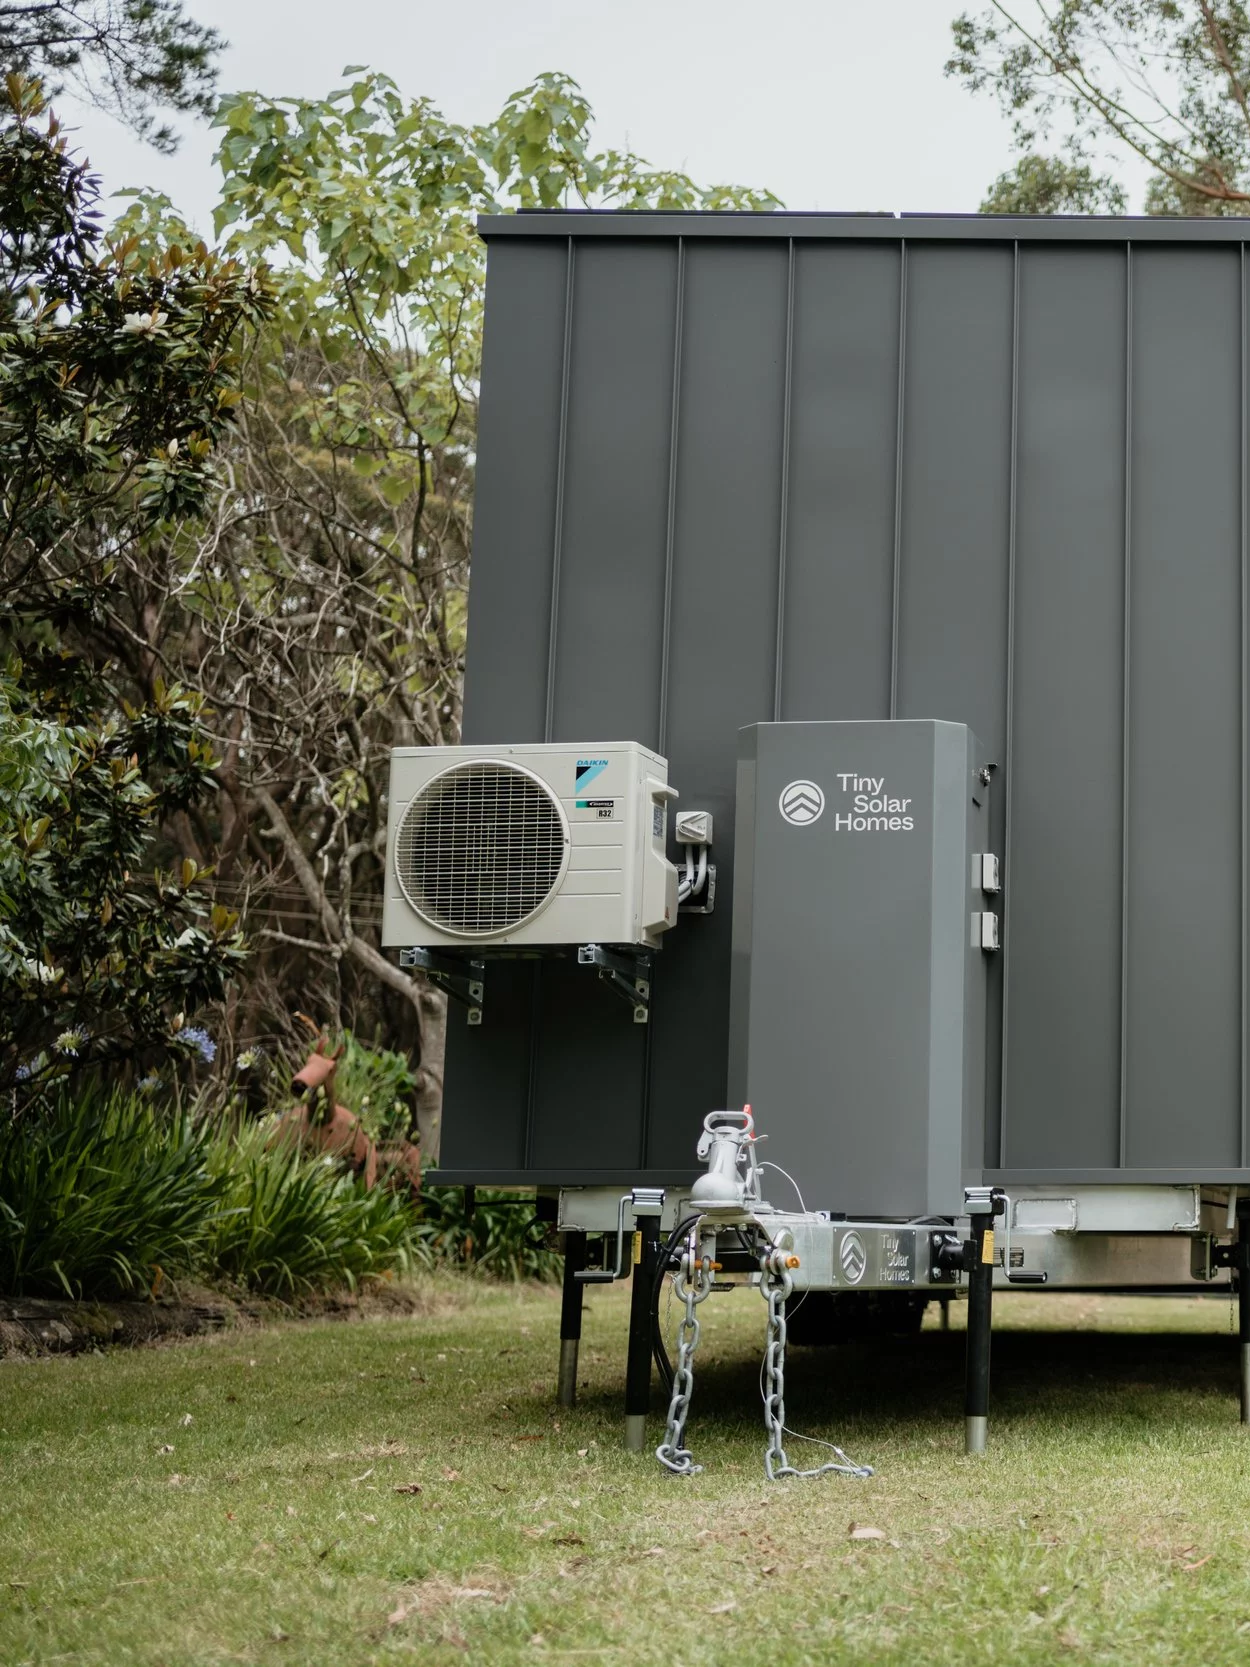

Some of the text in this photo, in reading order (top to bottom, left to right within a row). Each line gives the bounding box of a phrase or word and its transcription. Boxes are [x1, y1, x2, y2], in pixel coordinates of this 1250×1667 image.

[836, 773, 885, 796] Tiny
[853, 794, 912, 814] Solar
[835, 813, 914, 832] Homes
[880, 1234, 900, 1253] Tiny
[887, 1251, 910, 1267] Solar
[879, 1267, 910, 1281] Homes
